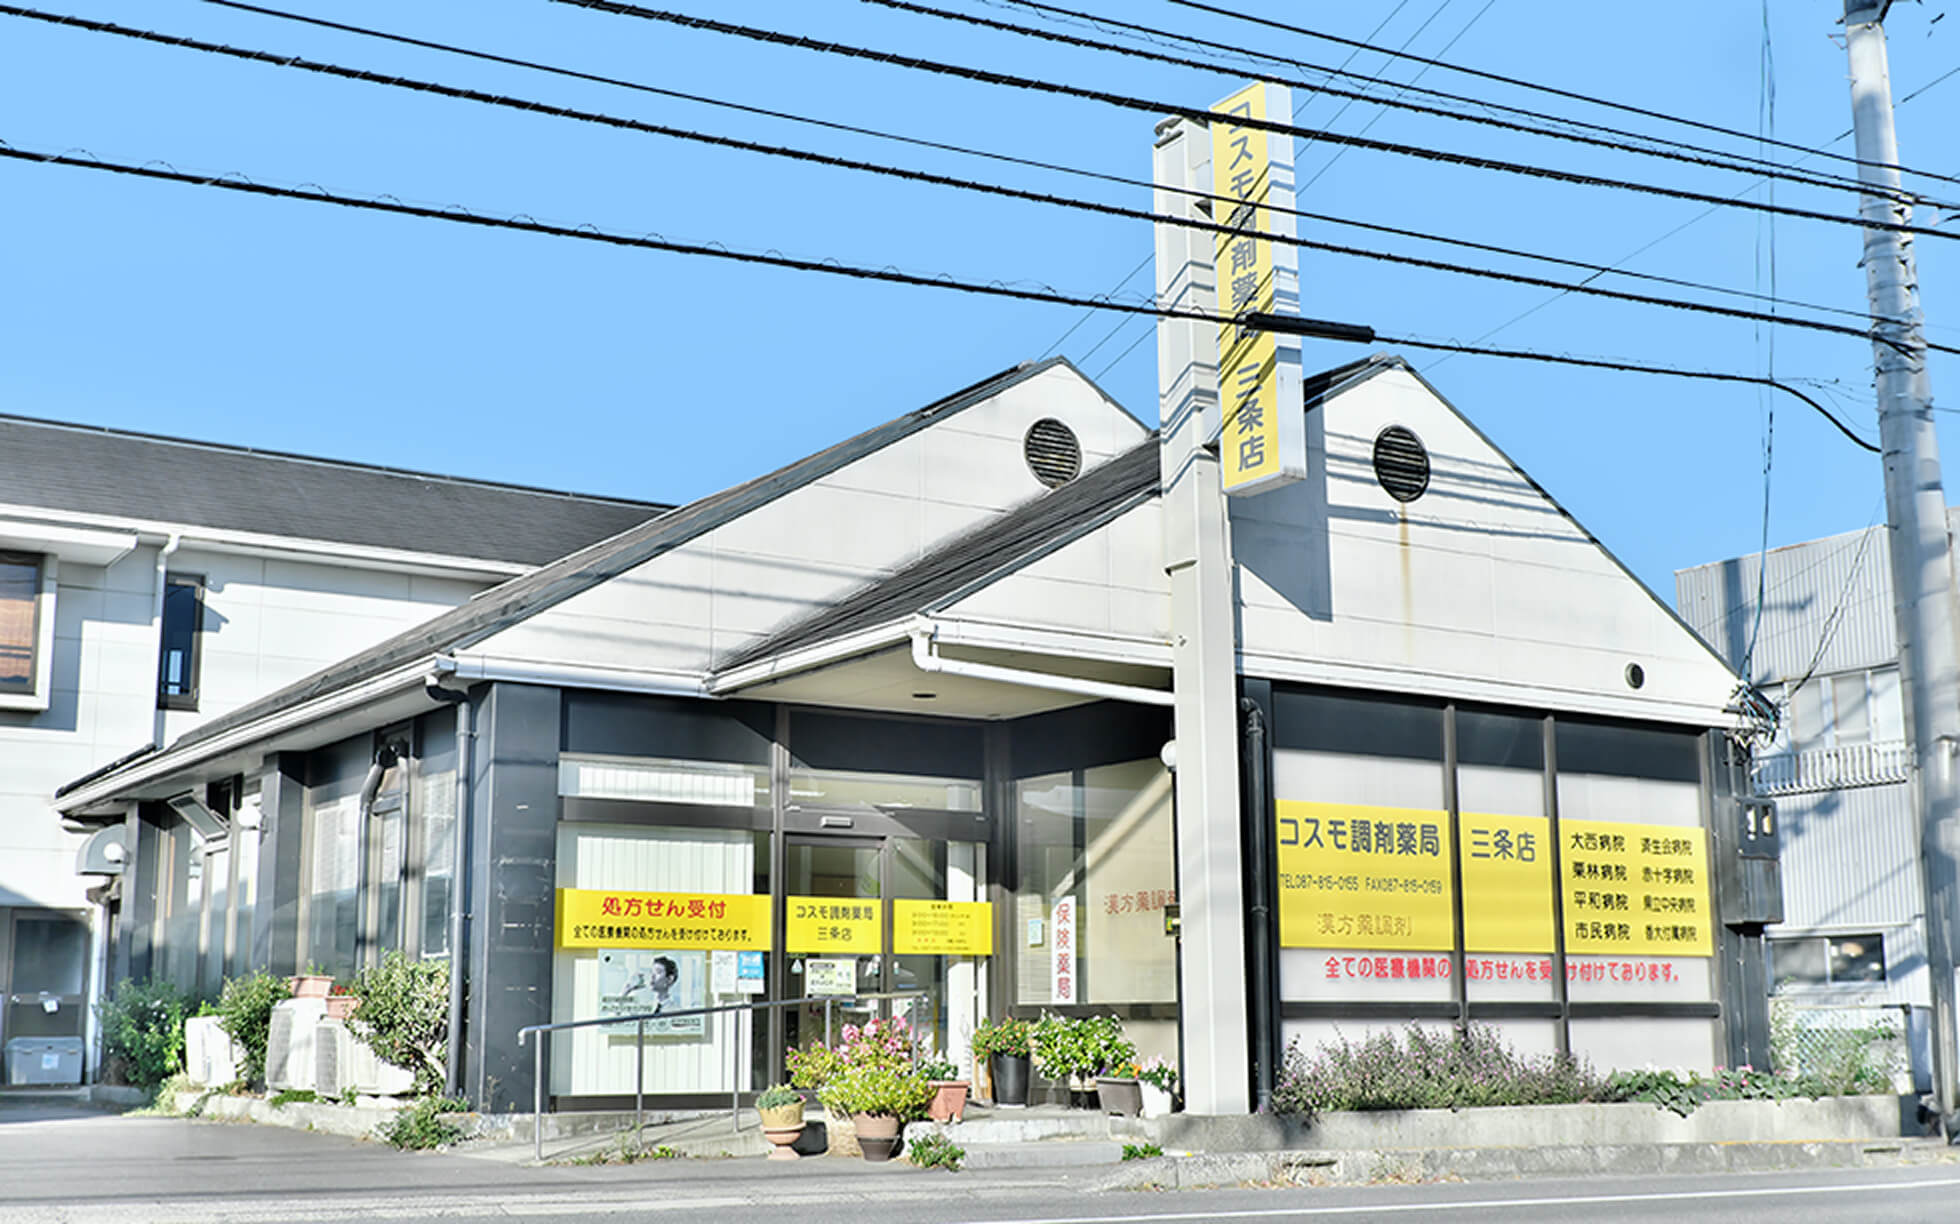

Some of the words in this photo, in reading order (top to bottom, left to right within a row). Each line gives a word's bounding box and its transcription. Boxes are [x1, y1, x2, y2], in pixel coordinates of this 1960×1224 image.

[1236, 362, 1265, 472] 三条店
[1280, 818, 1440, 857] コスモ調剤薬局
[1471, 829, 1536, 862] 三条店
[1571, 832, 1626, 853] 大西病院
[1573, 860, 1628, 881] 栗林病院
[601, 896, 727, 919] 処方せん受付
[1574, 890, 1629, 911] 平和病院
[795, 904, 874, 921] コスモ調剤薬局
[817, 925, 853, 942] 三条店
[1576, 921, 1631, 941] 市民病院
